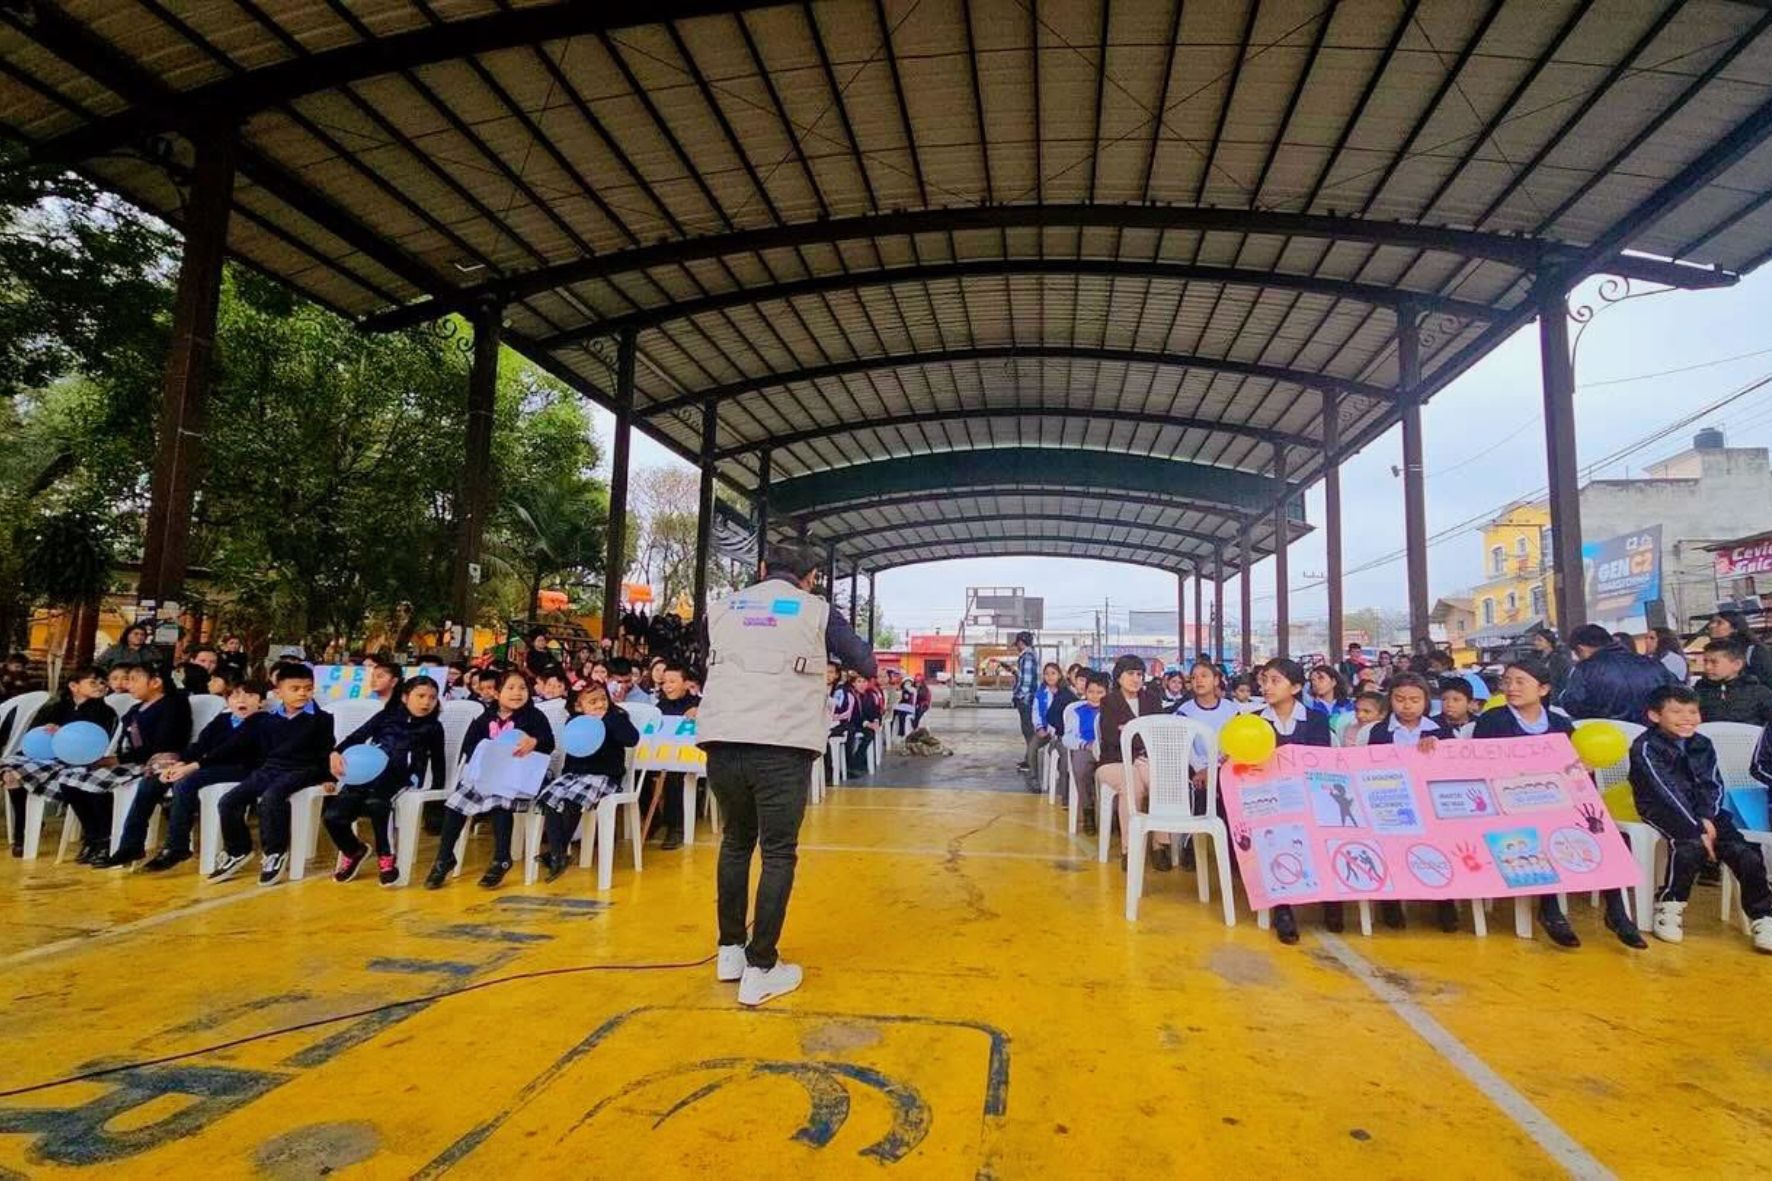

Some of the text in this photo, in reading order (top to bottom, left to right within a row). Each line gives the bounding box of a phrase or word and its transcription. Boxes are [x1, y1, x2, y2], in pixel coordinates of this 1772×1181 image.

[1276, 741, 1557, 770] NO A LA IOLENCIA
